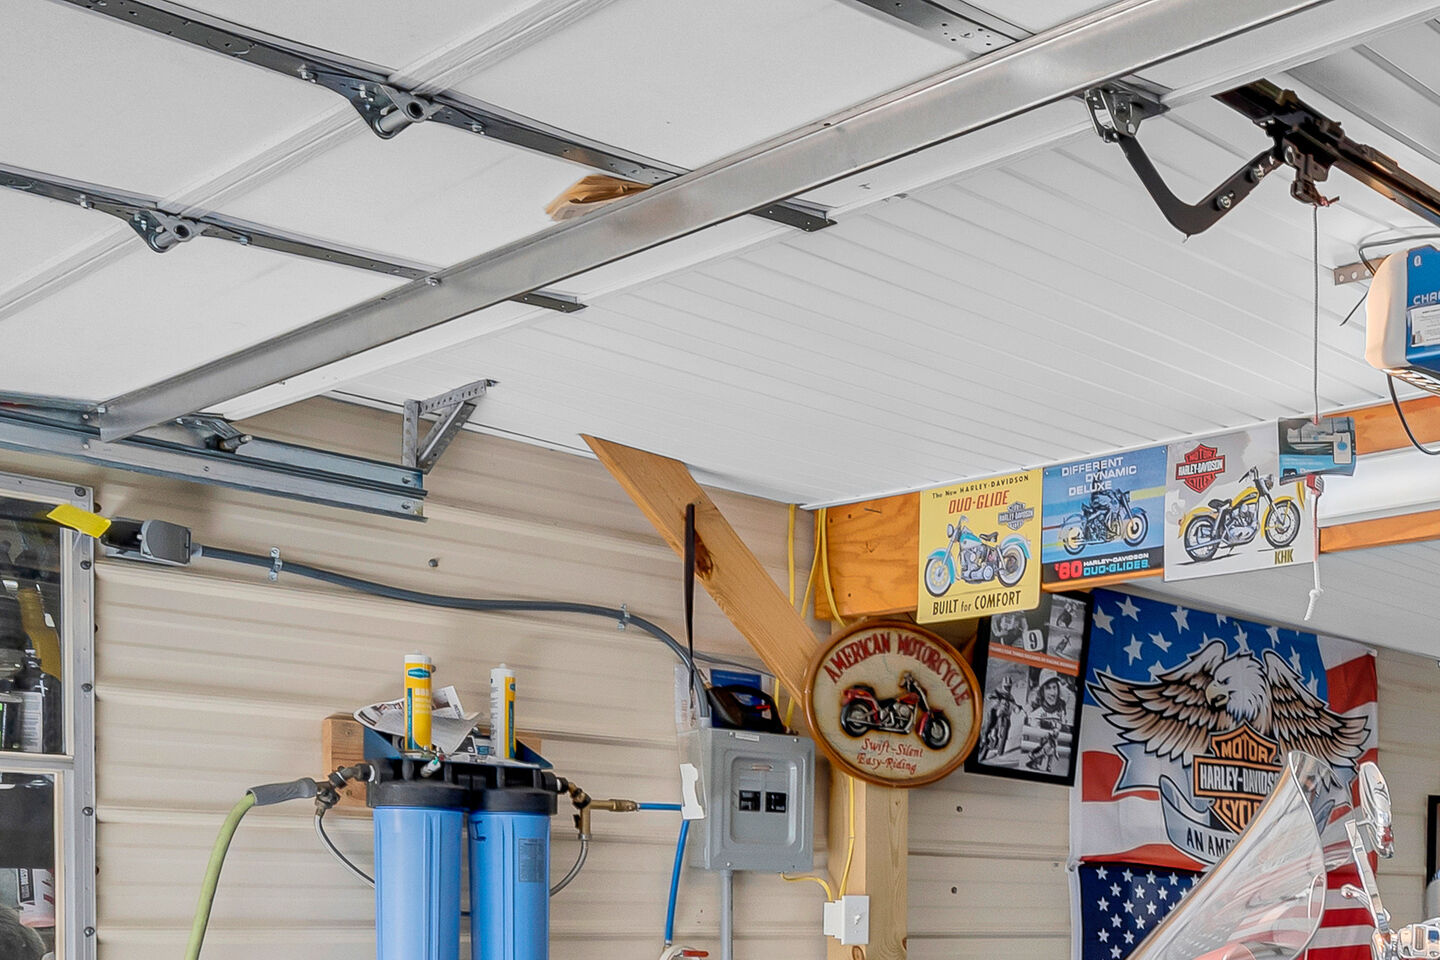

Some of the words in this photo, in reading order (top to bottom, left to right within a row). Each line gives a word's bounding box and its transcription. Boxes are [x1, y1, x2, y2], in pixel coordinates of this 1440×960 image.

[1061, 457, 1124, 477] DIFFERENT
[1085, 465, 1137, 483] DYNAMIC
[959, 474, 1029, 494] HARLEY-DAVIDSON
[1068, 480, 1113, 497] DELUXE
[948, 490, 1010, 514] DUO-GLIDE
[1083, 553, 1149, 567] HARLEY-DAVIDSON
[1274, 548, 1294, 565] KHK
[932, 599, 959, 616] BUILT
[961, 600, 972, 612] for
[974, 591, 1021, 610] COMFORT
[1028, 631, 1038, 650] 9
[823, 632, 891, 684] AMERICAN
[897, 633, 970, 706] MOTORCYCLE
[1221, 736, 1269, 763] MOTOR
[1186, 827, 1205, 852] AN
